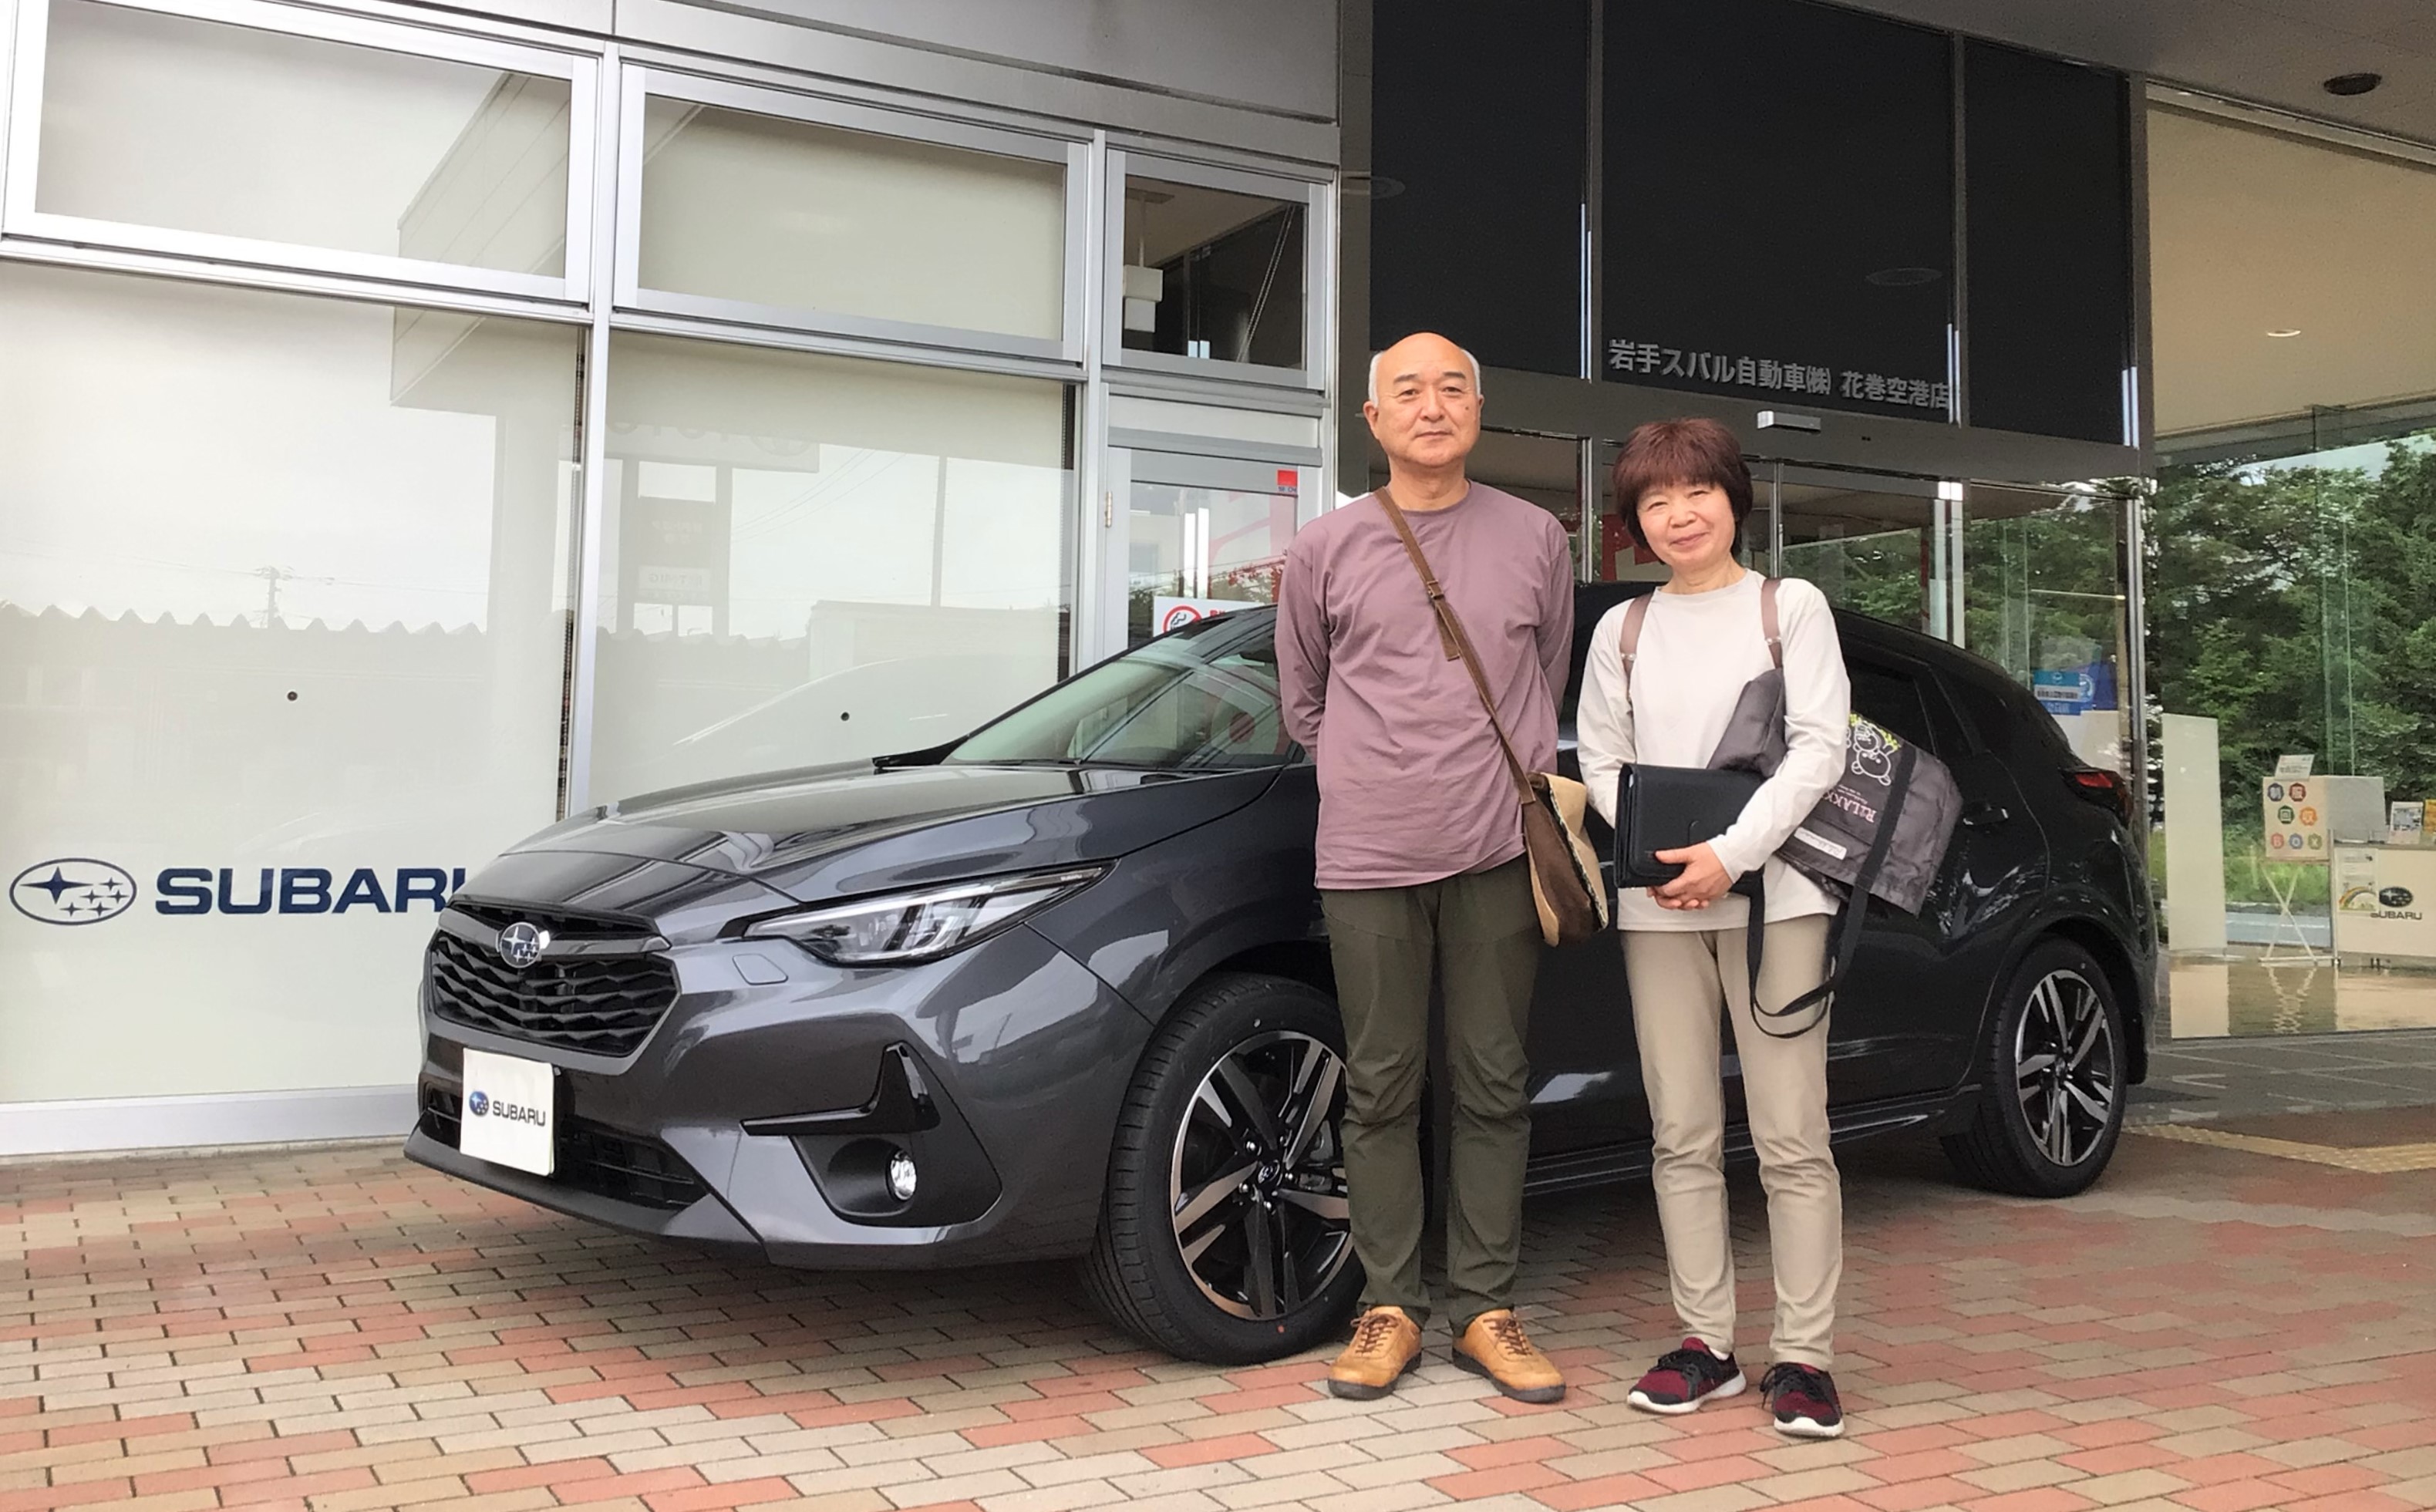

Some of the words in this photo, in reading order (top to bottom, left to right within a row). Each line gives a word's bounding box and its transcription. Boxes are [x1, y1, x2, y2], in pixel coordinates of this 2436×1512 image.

[1840, 370, 1951, 409] 花巻空港店
[1824, 792, 1878, 823] RILAKK
[492, 1100, 547, 1127] SUBARU
